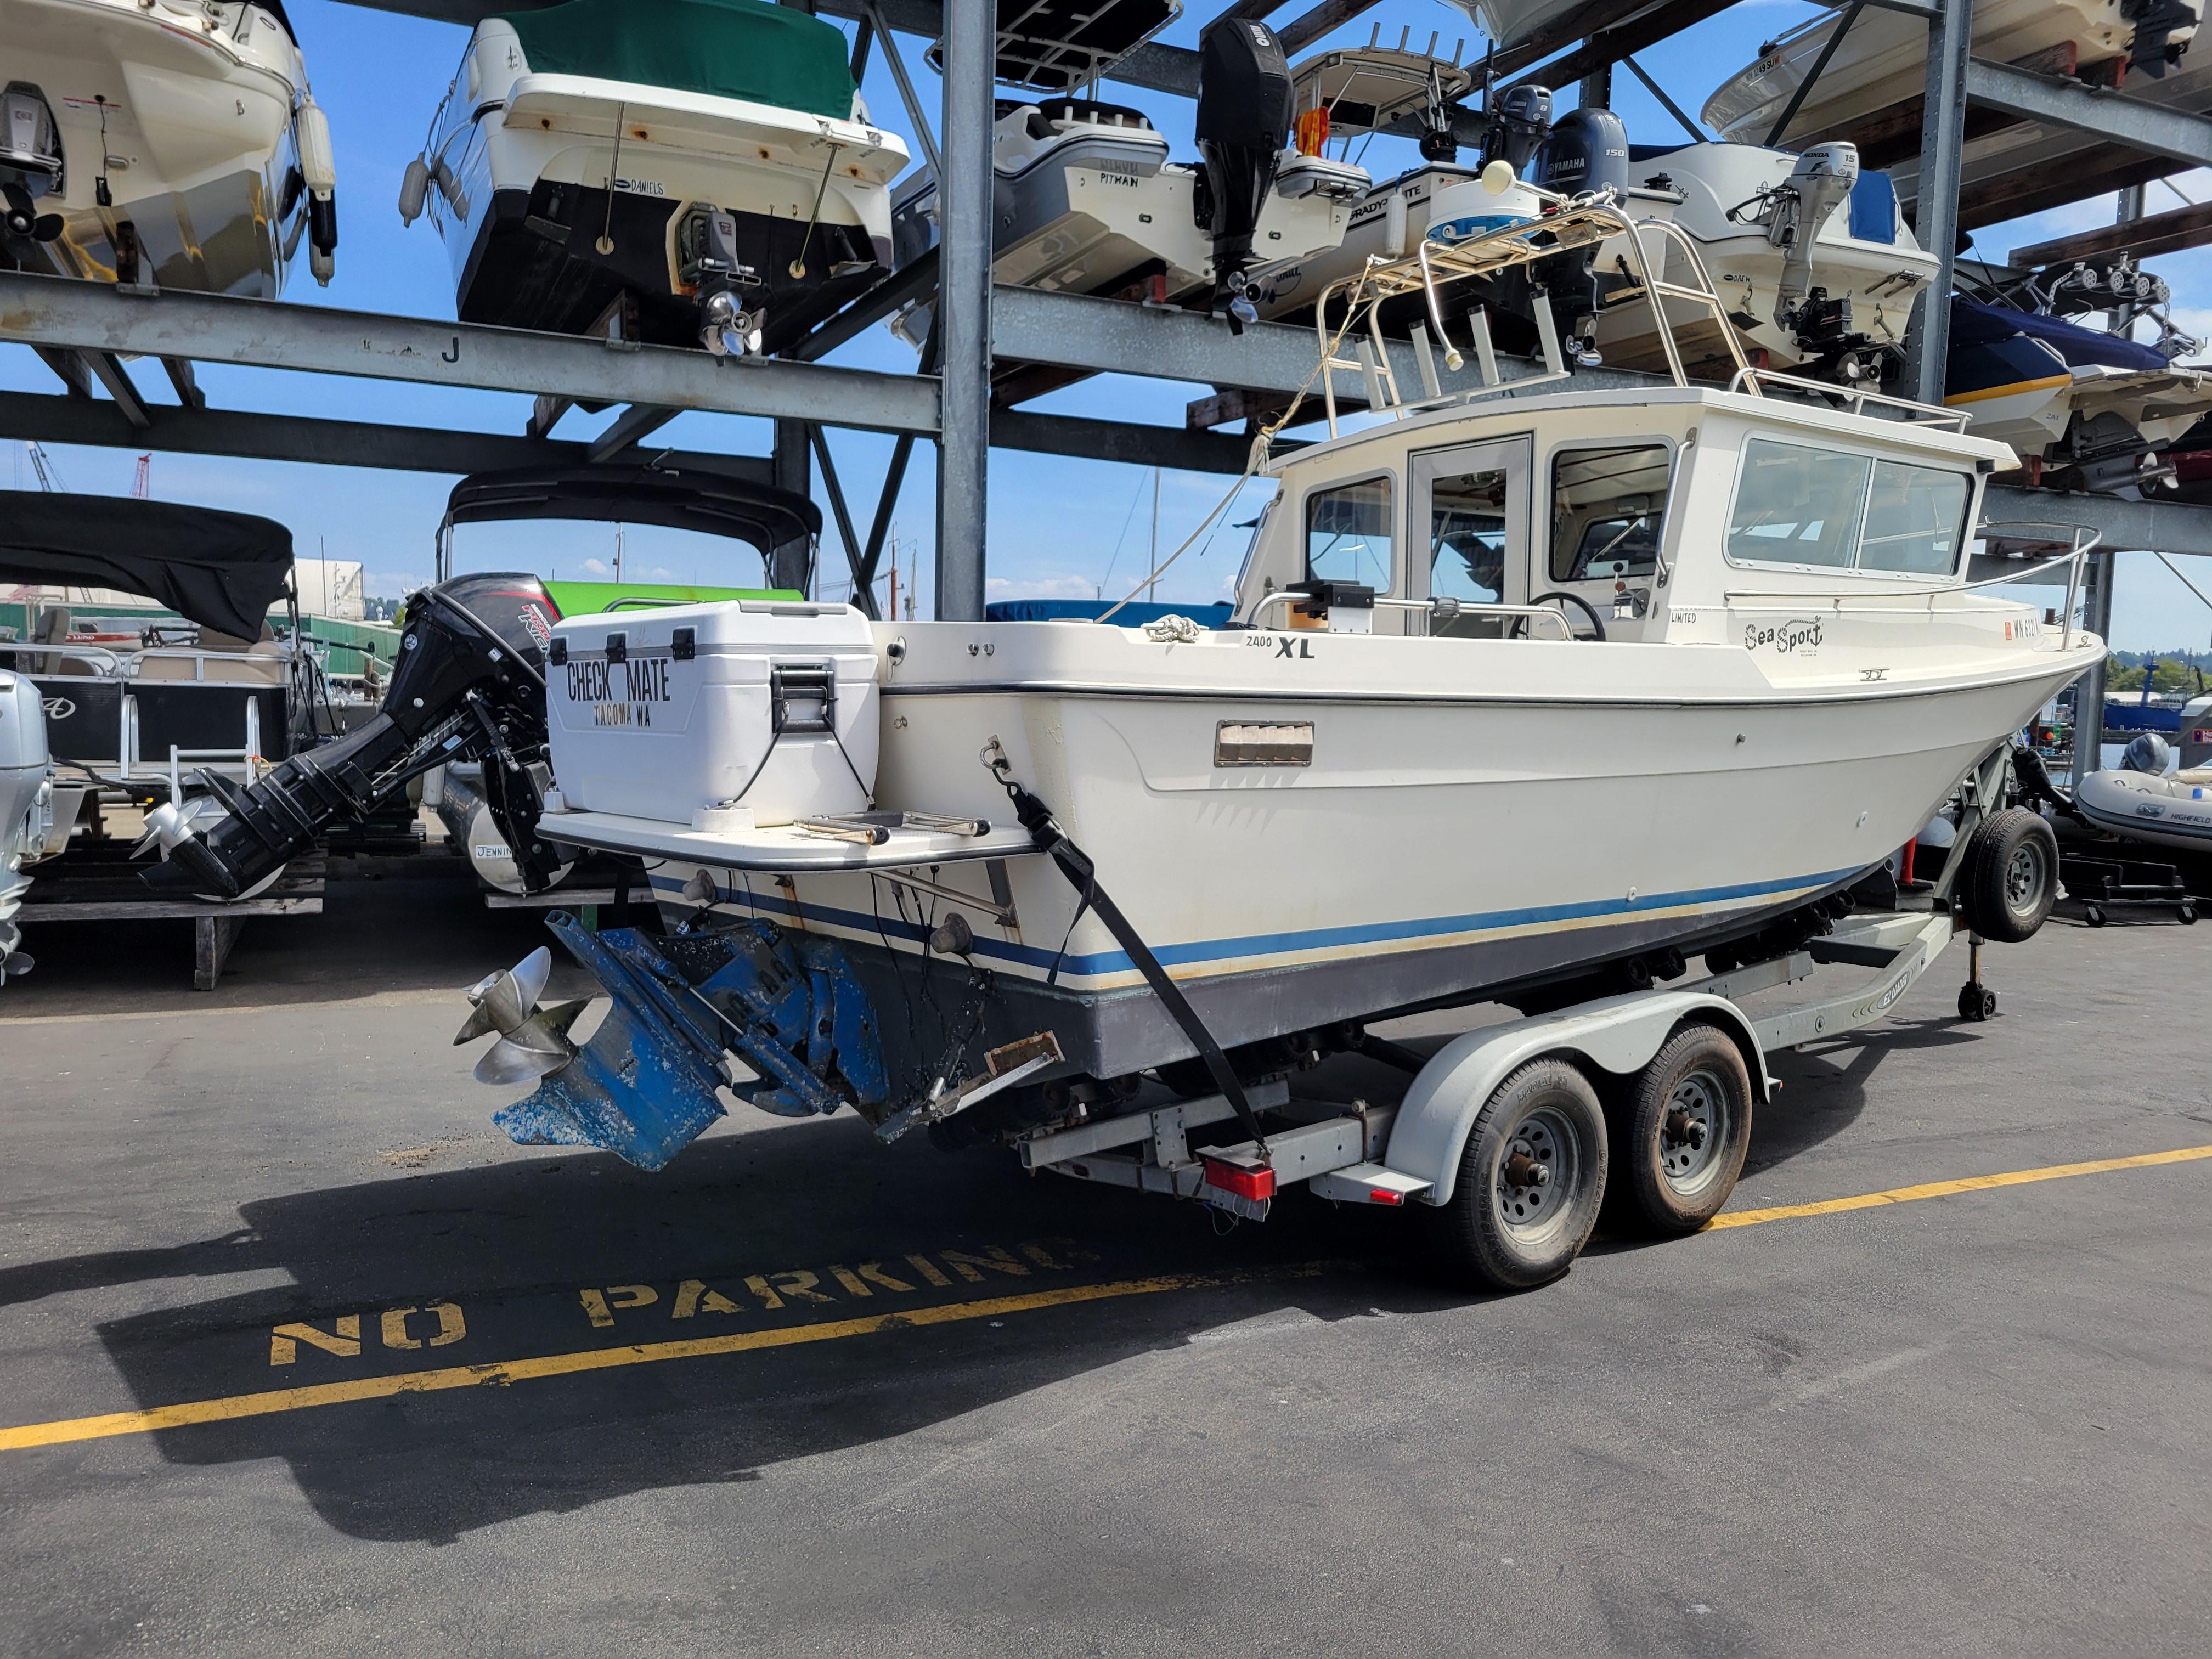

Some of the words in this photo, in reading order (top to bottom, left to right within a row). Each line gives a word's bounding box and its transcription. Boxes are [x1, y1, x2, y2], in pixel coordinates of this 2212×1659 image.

[1767, 58, 1774, 70] SU
[1605, 149, 1625, 157] 150
[1845, 154, 1856, 163] 15
[1554, 157, 1585, 173] YAMAHA
[631, 179, 664, 195] DANIELS
[1733, 274, 1751, 283] DREW
[442, 336, 460, 363] J
[1671, 612, 1696, 624] LIMITED
[1745, 623, 1774, 651] Sea
[1776, 617, 1823, 653] Sport
[1246, 636, 1272, 647] 2400
[1274, 636, 1315, 659] XL
[567, 660, 613, 702] CHECK
[625, 658, 671, 702] MATE
[594, 703, 632, 726] TACOMA
[636, 704, 651, 727] WA
[2170, 813, 2211, 823] HIGHFIELD
[1517, 1075, 1553, 1104] RADIAL
[579, 1237, 1100, 1328] PARKING
[270, 1302, 466, 1366] NO
